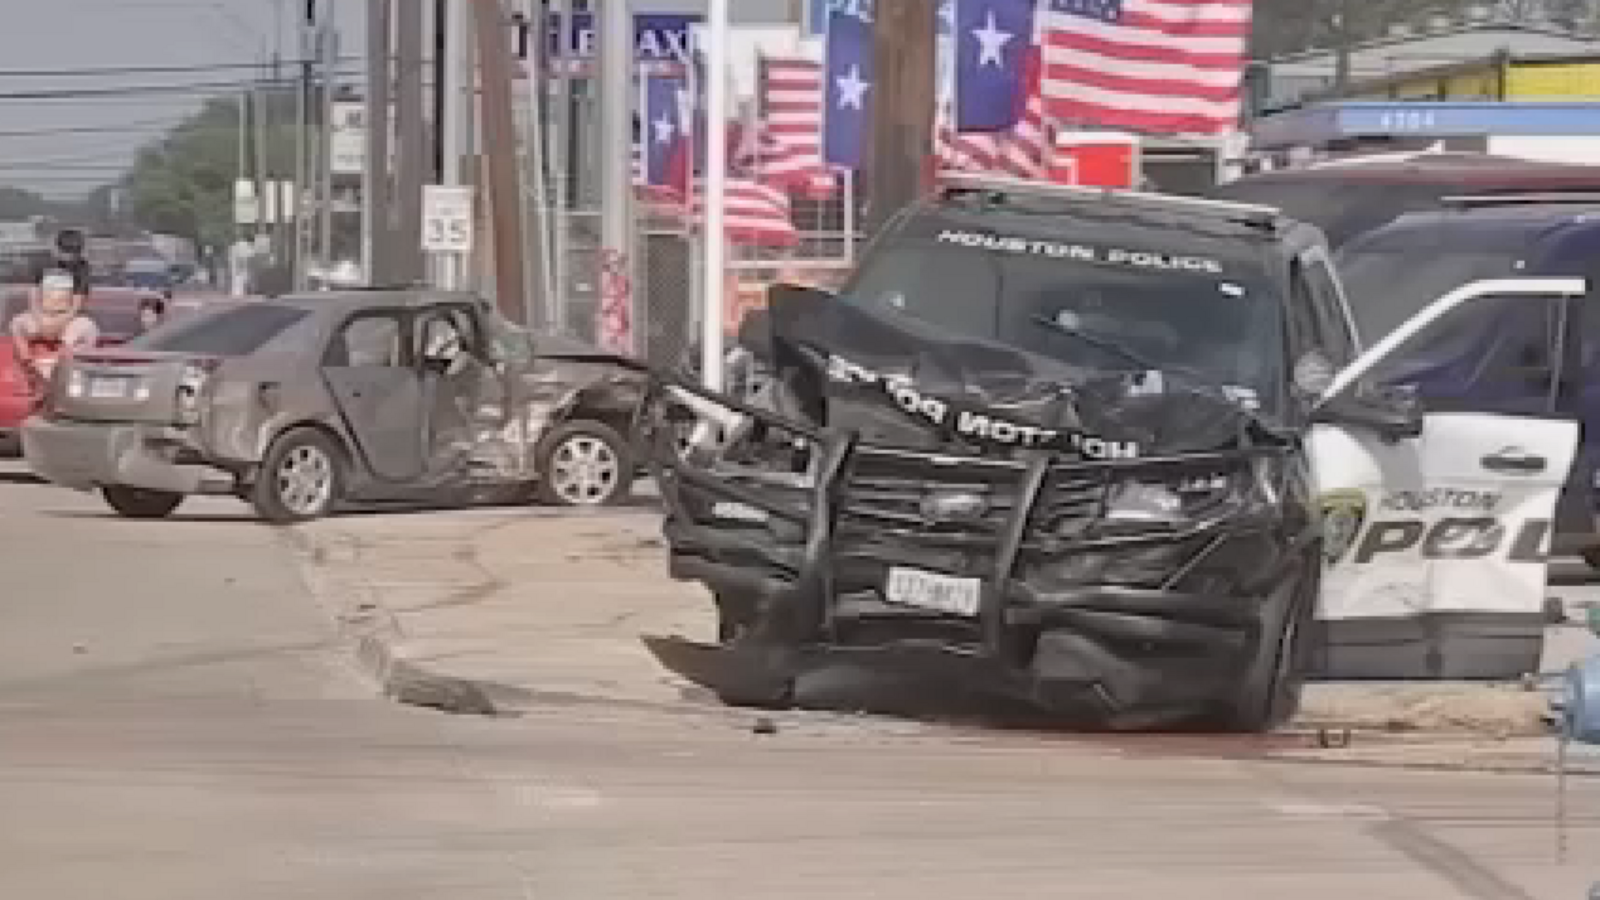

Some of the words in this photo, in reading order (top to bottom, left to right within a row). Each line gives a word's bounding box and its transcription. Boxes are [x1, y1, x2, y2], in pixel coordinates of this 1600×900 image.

[428, 218, 467, 243] 35
[938, 229, 1094, 258] HOUSTON
[1107, 249, 1222, 273] POLICE
